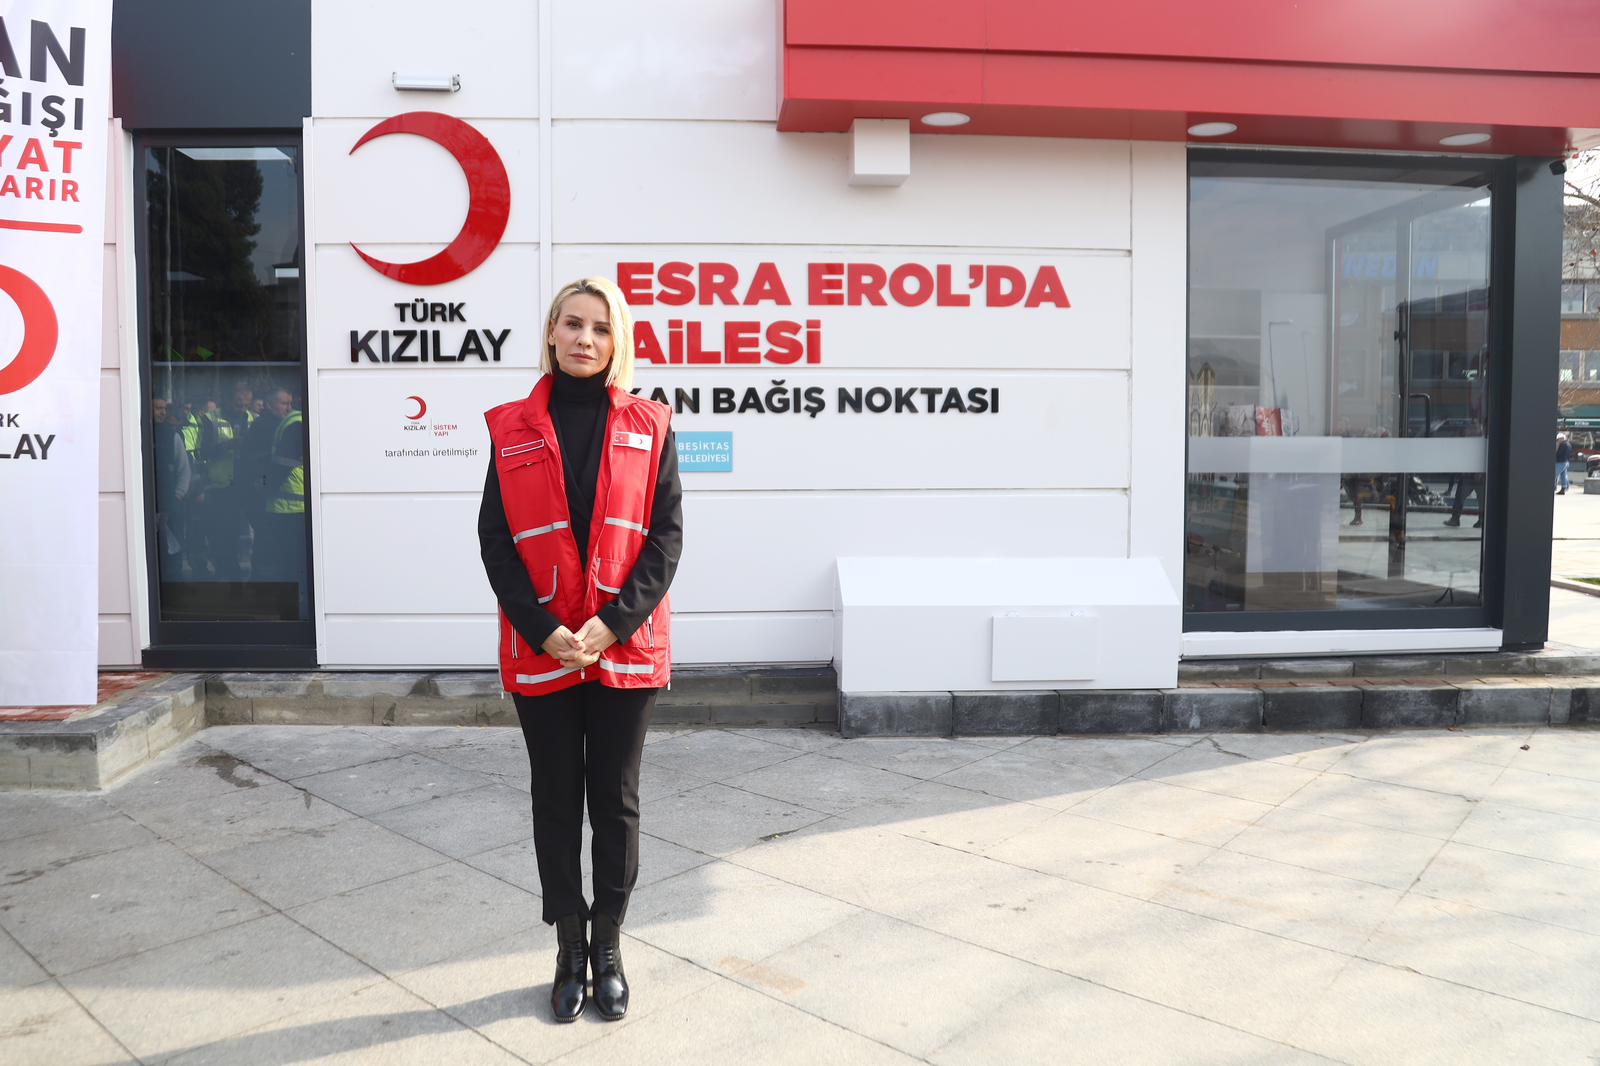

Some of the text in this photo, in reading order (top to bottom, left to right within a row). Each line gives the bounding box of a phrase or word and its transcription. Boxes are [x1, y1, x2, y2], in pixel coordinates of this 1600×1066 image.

[617, 261, 792, 306] ESRA
[394, 298, 467, 323] TÜRK
[349, 329, 512, 363] KIZILAY
[630, 379, 1000, 418] AN BAĞIŞ NOKTASI
[384, 448, 477, 458] tarafından üretilmiştir
[678, 452, 729, 462] BELEDİYESİ
